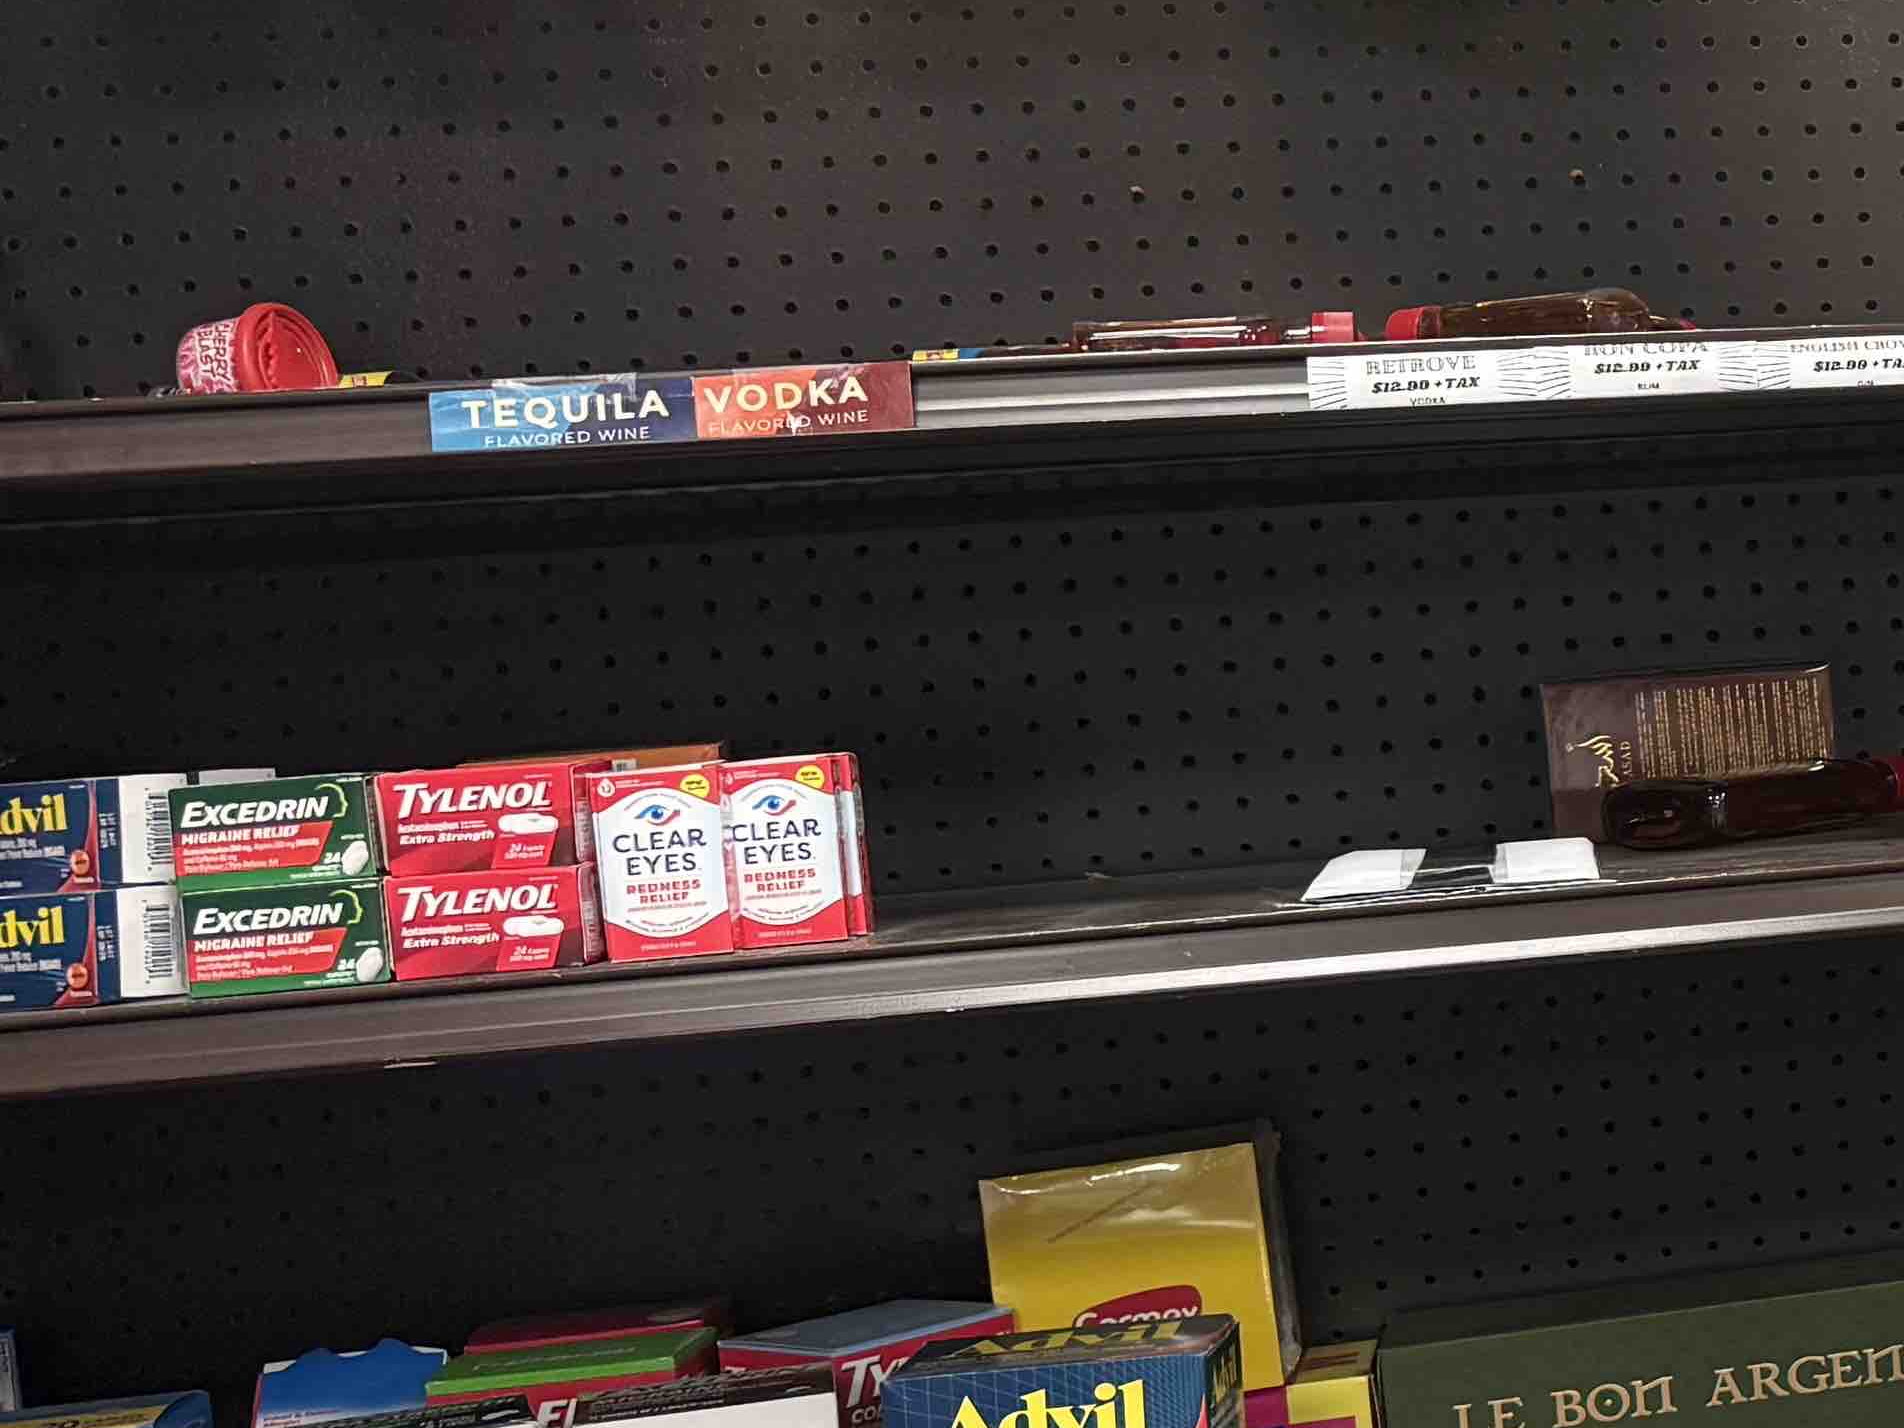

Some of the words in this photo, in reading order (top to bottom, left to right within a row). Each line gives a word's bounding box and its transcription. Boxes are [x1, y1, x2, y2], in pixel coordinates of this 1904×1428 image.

[703, 375, 868, 413] VODKA
[461, 390, 670, 428] TEQUILA
[815, 409, 868, 427] WINE
[484, 427, 591, 447] FLAVORED
[597, 426, 651, 442] WINE
[393, 781, 551, 812] TYLENOL
[180, 795, 328, 828] EXCEDRIN
[180, 829, 248, 845] MIGRAINE
[252, 825, 300, 839] RELIEF
[613, 828, 707, 854] CLEAR
[730, 819, 821, 843] CLEAR
[626, 853, 696, 875] EYES
[745, 843, 812, 864] EYES
[626, 879, 700, 895] REDNESS
[640, 892, 689, 904] RELIEF
[397, 885, 556, 917] TYLENOL
[192, 903, 343, 934] EXCEDRIN
[1552, 1377, 1674, 1428] BON
